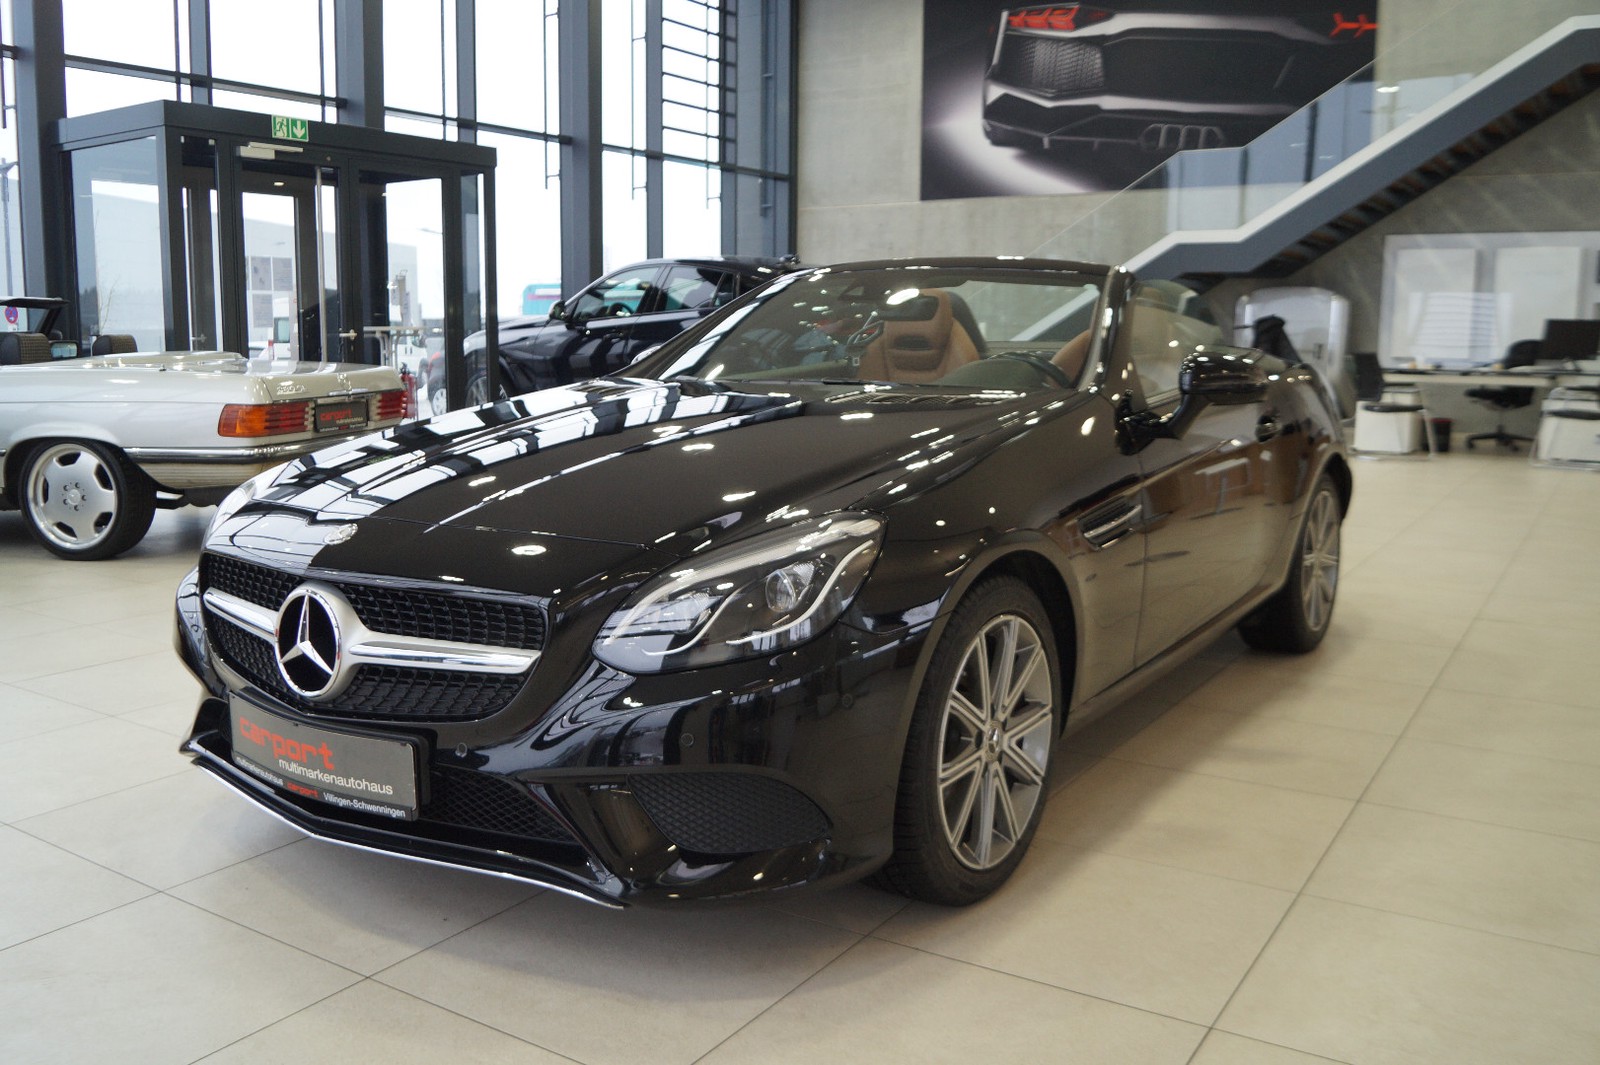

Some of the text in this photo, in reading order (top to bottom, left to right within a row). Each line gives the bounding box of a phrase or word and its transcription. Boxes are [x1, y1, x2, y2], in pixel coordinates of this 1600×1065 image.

[239, 716, 335, 770] carport
[278, 758, 394, 795] multimarkenautohaus
[287, 782, 319, 798] carport
[323, 792, 406, 818] Villingen-Schwenningen
